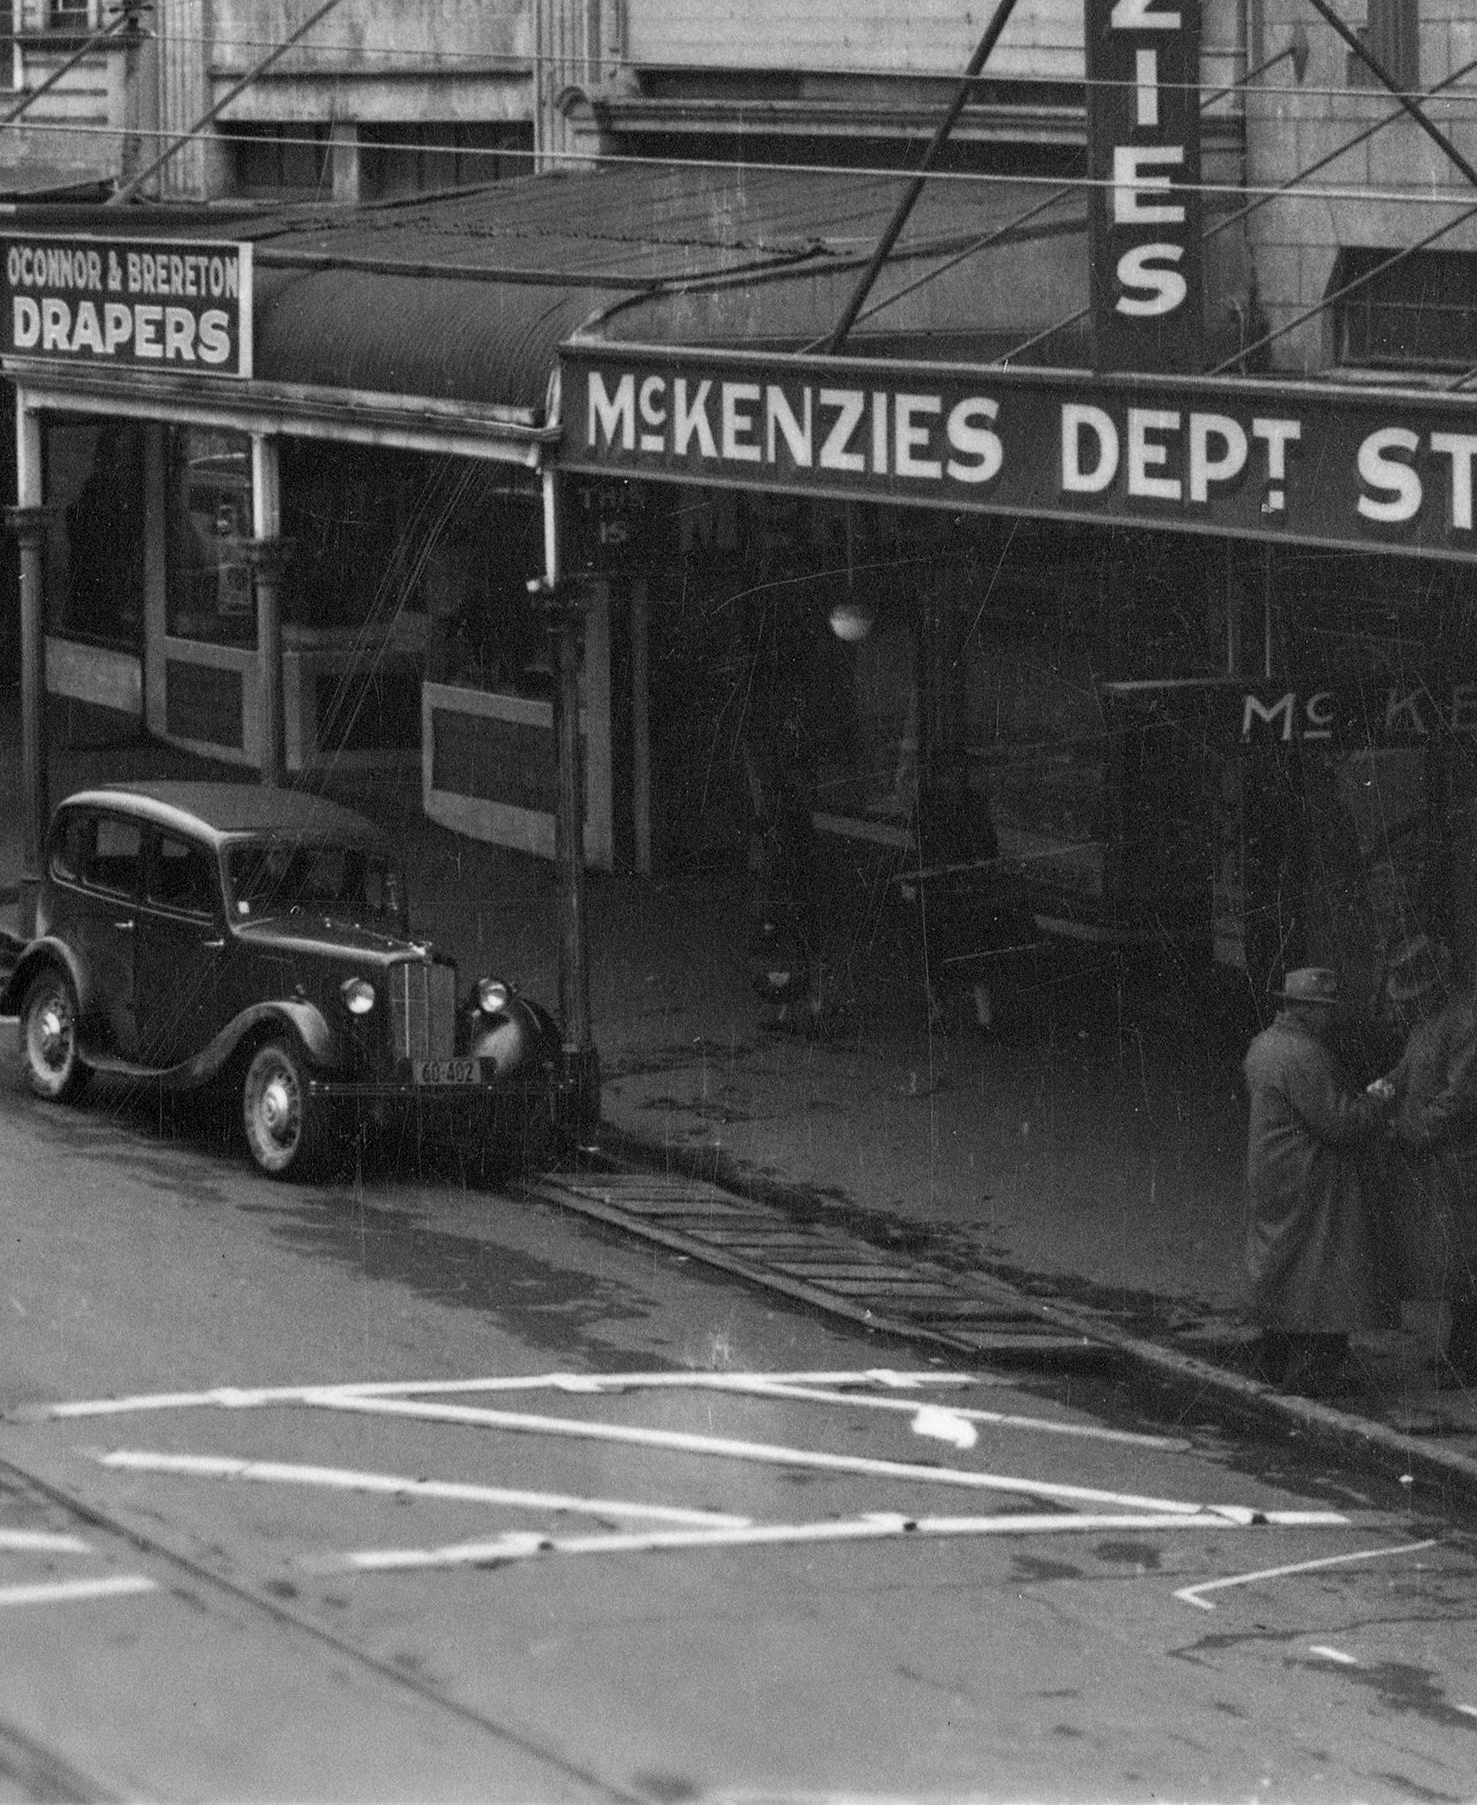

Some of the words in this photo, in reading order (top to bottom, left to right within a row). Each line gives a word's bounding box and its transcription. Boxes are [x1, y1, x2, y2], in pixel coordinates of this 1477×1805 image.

[107, 256, 122, 291] &
[128, 251, 239, 298] BRERETON
[13, 295, 232, 365] DRAPERS
[587, 371, 1003, 483] McKENZIES
